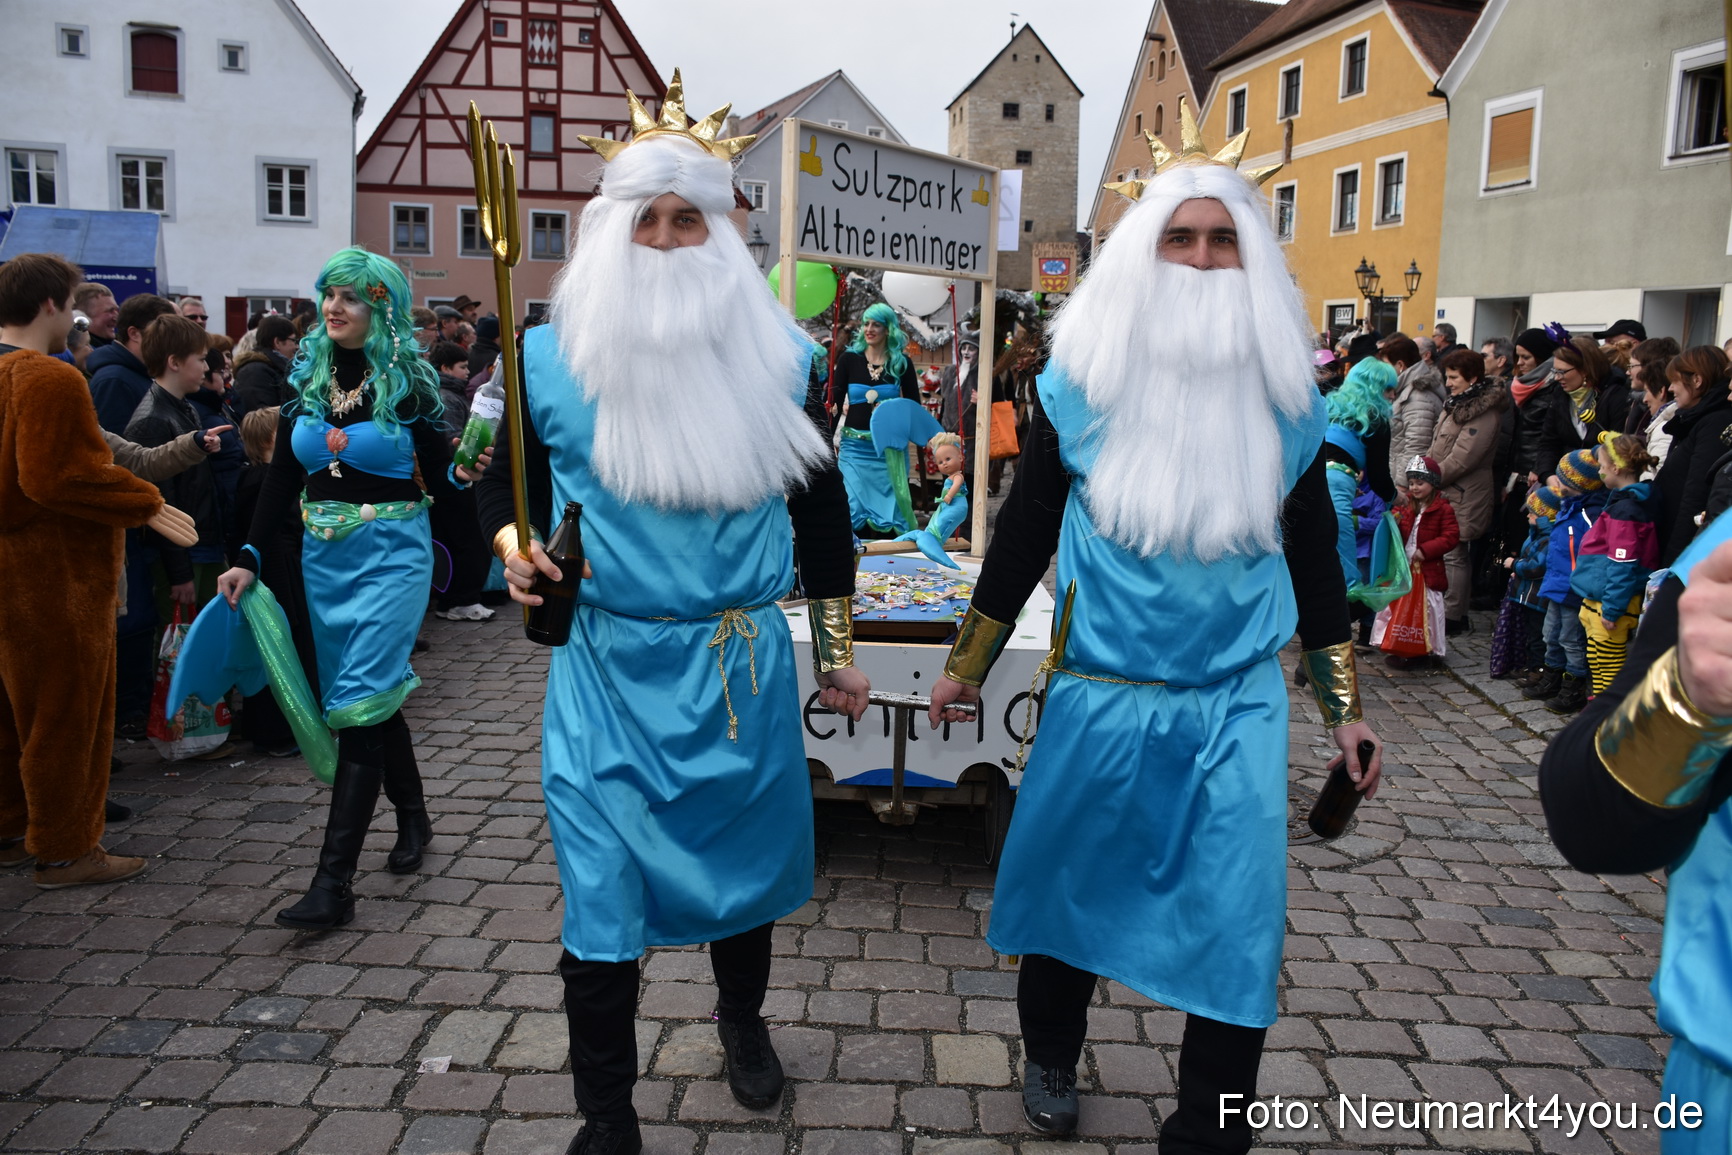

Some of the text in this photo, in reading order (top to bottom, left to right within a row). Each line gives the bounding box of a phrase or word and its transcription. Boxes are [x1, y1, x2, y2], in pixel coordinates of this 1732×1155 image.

[832, 142, 963, 214] Sulzpark
[801, 203, 982, 271] Altneieninger
[1336, 308, 1351, 318] BW
[1391, 624, 1424, 639] ESPR
